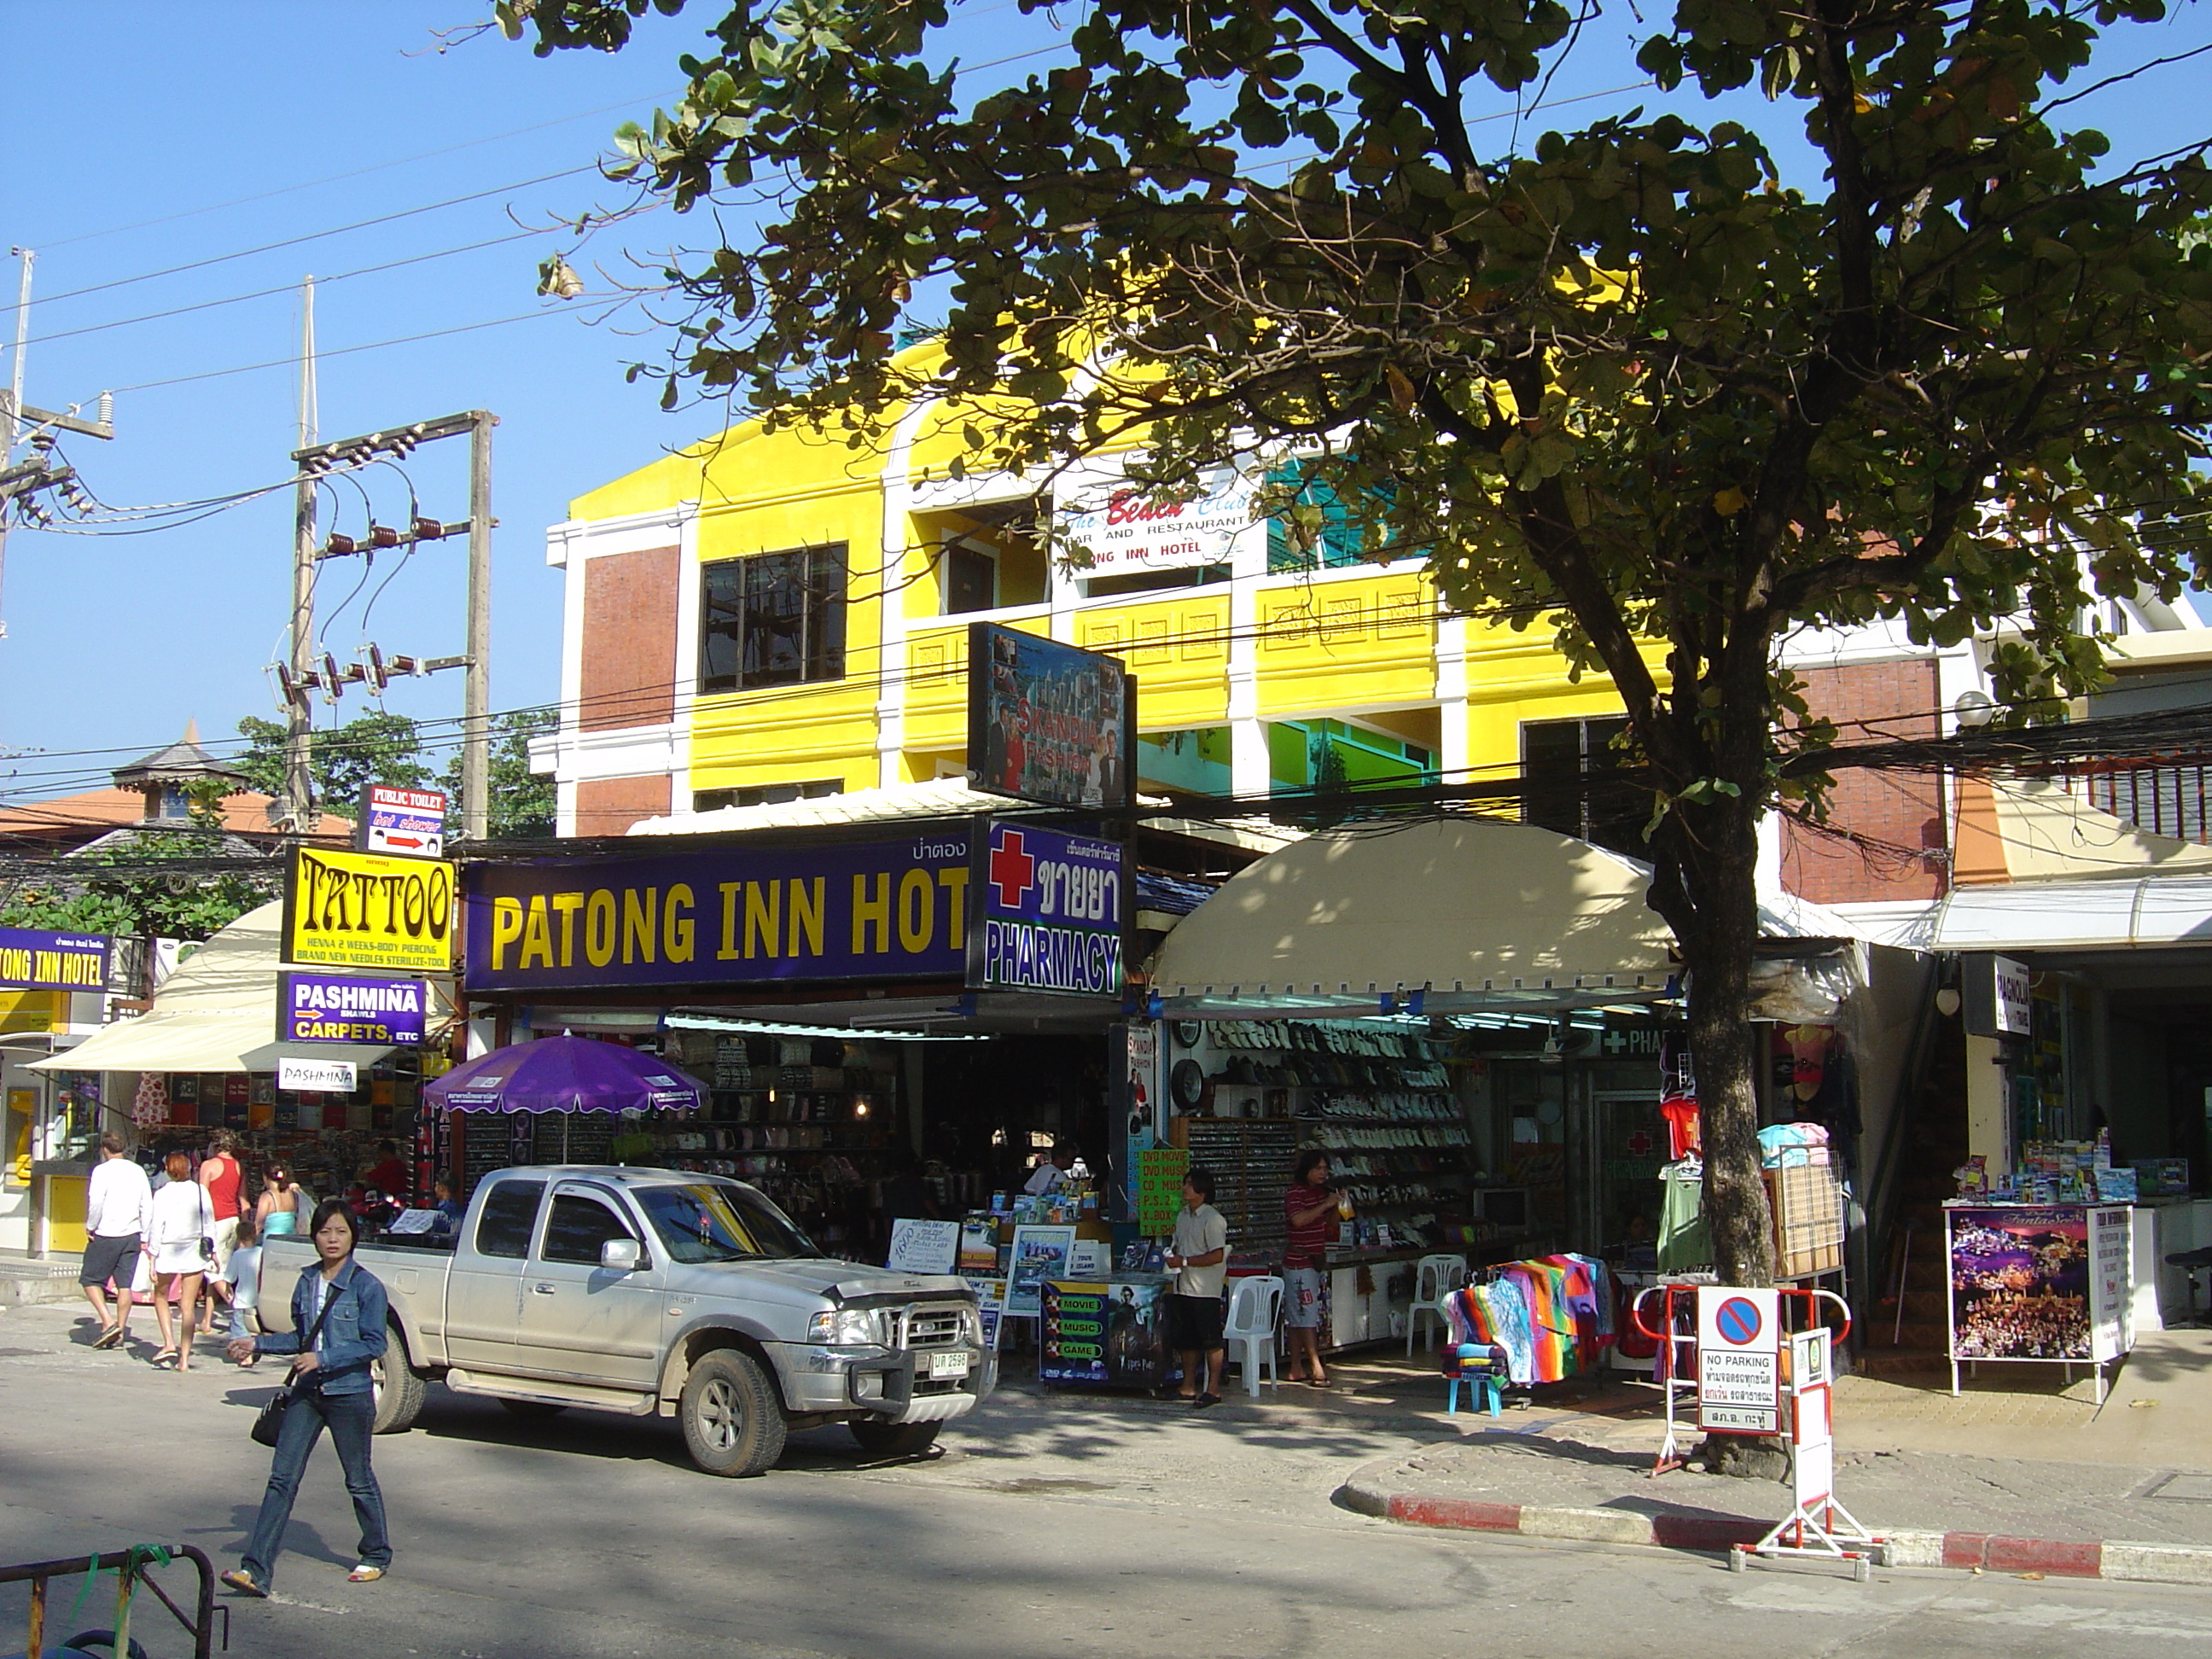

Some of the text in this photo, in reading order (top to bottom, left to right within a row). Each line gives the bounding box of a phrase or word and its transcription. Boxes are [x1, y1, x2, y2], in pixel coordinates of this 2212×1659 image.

[1197, 491, 1249, 515] Club
[1105, 528, 1133, 540] AND
[1147, 515, 1245, 535] RESTAURANT
[1126, 547, 1149, 560] INN
[1161, 542, 1202, 556] HOTEL
[1018, 697, 1098, 749] SKANDIA
[1026, 740, 1091, 775] FASHION
[374, 788, 442, 809] PUBLIC TOILET
[373, 811, 441, 833] hot shower
[913, 837, 967, 859] ป่าตอง
[301, 851, 451, 942] TATTOO
[1038, 860, 1120, 923] ขายยา
[491, 867, 970, 971] PATONG INN HOT
[307, 938, 437, 954] HENNA 2 WEEKS-BODY PIERCING
[296, 950, 326, 960] BRAND
[329, 952, 346, 962] NEW
[350, 954, 384, 964] NEEDLES
[984, 920, 1121, 993] PHARMACY
[34, 950, 61, 983] INN
[62, 952, 102, 987] HOTEL
[295, 984, 418, 1013] PASHMINA
[1997, 975, 2029, 1005] MAGNOLIA
[341, 1010, 376, 1018] SHAWLS
[296, 1022, 419, 1043] CARPETS, ETC
[1630, 1029, 1670, 1054] PHA
[1128, 1036, 1152, 1055] SKANDIA
[1131, 1057, 1151, 1068] FASHION
[284, 1068, 352, 1083] PASHMINA
[1143, 1150, 1188, 1162] DVD MOVIE
[1143, 1165, 1160, 1177] DVD
[1143, 1180, 1183, 1191] CD MUS
[1063, 1301, 1095, 1310] MOVIE
[1063, 1324, 1097, 1332] MUSIC
[1063, 1346, 1092, 1355] GAME
[1707, 1355, 1769, 1368] NO PARKING
[1705, 1385, 1728, 1400] ยกเว้น
[1745, 1412, 1767, 1429] กะทู้
